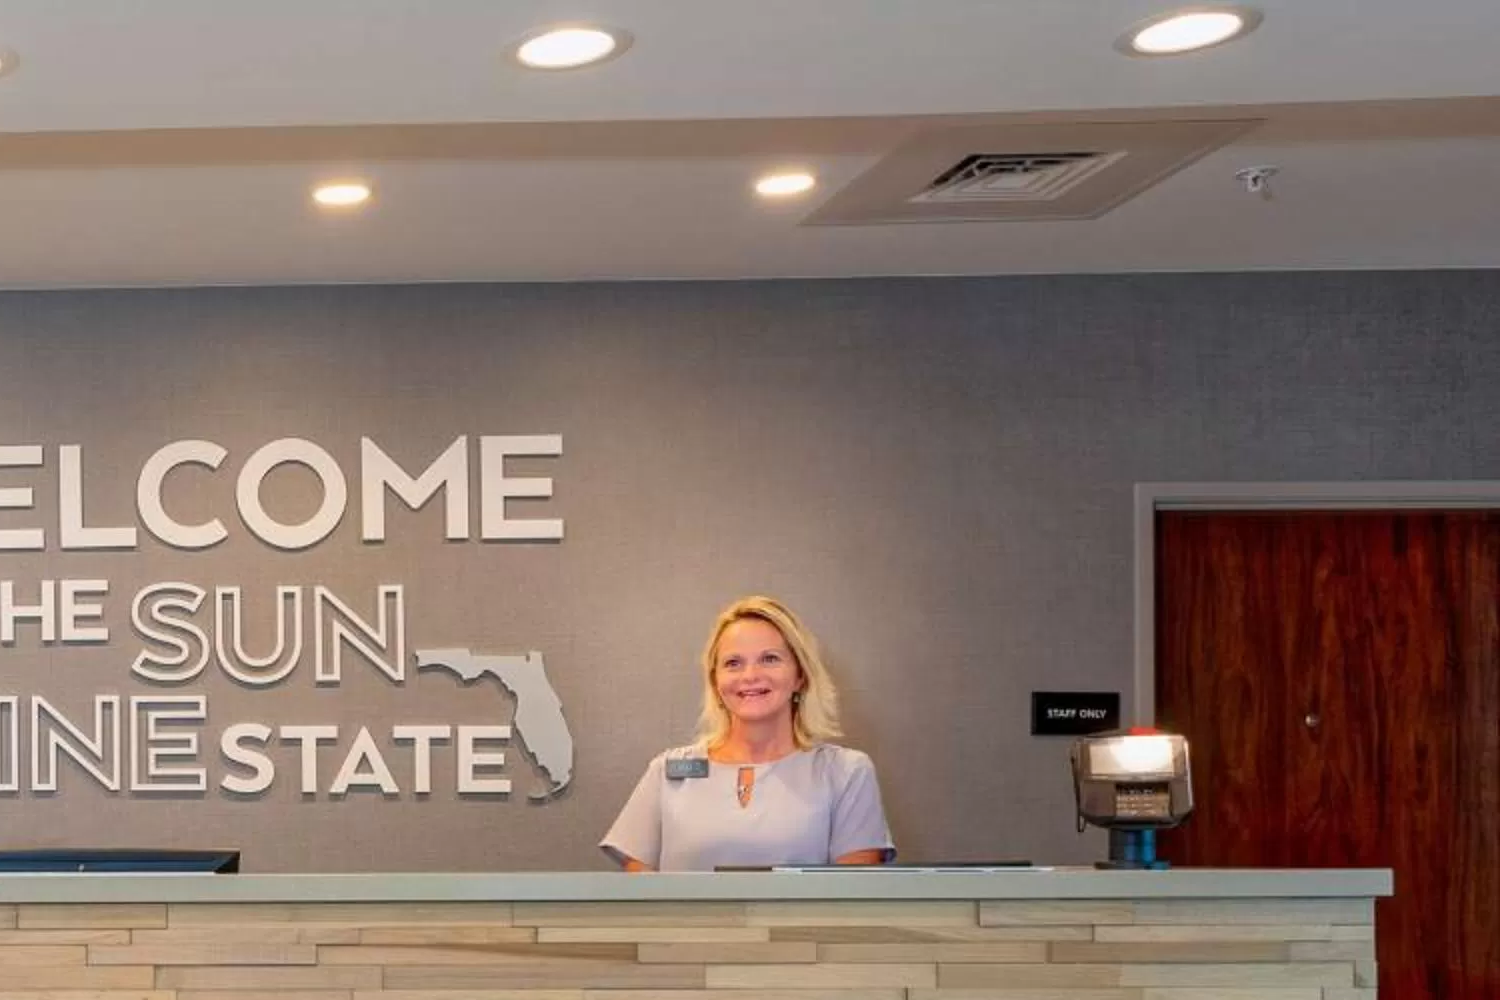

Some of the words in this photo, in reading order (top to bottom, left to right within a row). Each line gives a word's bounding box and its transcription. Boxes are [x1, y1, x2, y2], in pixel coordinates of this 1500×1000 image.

[130, 581, 406, 685] SUN
[1047, 708, 1077, 719] STAFF
[1079, 708, 1107, 719] ONLY
[219, 722, 513, 796] STATE
